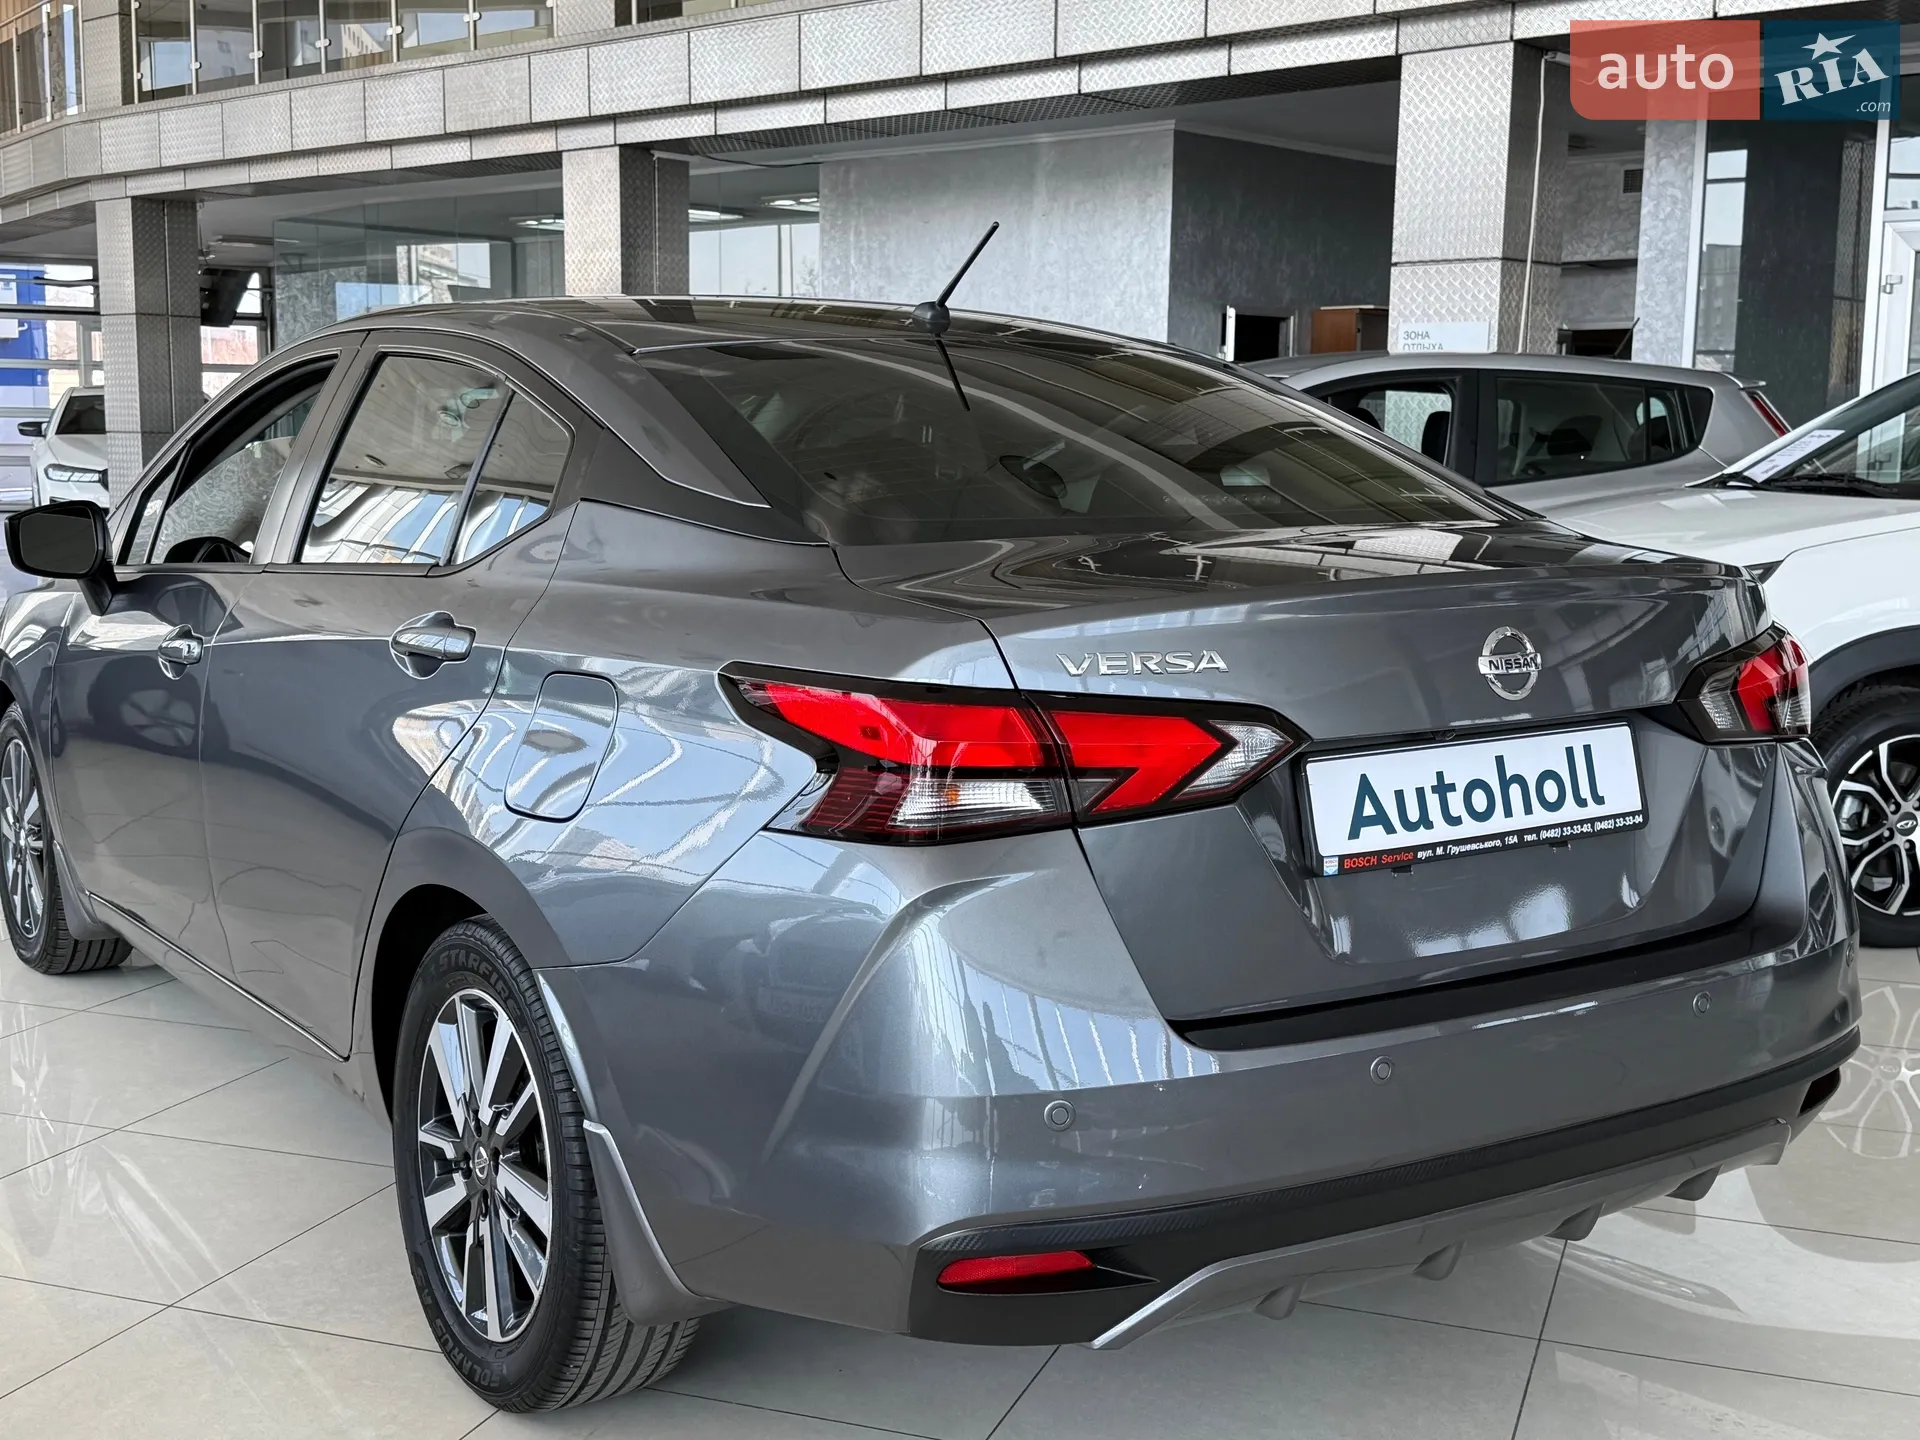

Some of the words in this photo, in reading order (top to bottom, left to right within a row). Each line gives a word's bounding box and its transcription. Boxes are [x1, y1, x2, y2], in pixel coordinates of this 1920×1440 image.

[1403, 331, 1430, 340] ЗОНА
[1056, 650, 1229, 677] VERSA
[1488, 653, 1540, 671] NISSAN
[1348, 744, 1606, 841] Autoholl
[1344, 855, 1377, 869] BOSCH
[1382, 852, 1414, 864] Service
[1417, 849, 1434, 860] вул.
[1436, 846, 1445, 856] М.
[1447, 840, 1503, 856] Грушевського,
[1504, 836, 1518, 845] 15А
[1523, 833, 1538, 842] тел.
[1540, 828, 1561, 840] (0482)
[1594, 819, 1615, 833] (0482)
[1615, 814, 1643, 827] 33-33-04
[439, 948, 521, 1018] STARFIRE
[432, 1317, 502, 1388] SOLARUS
